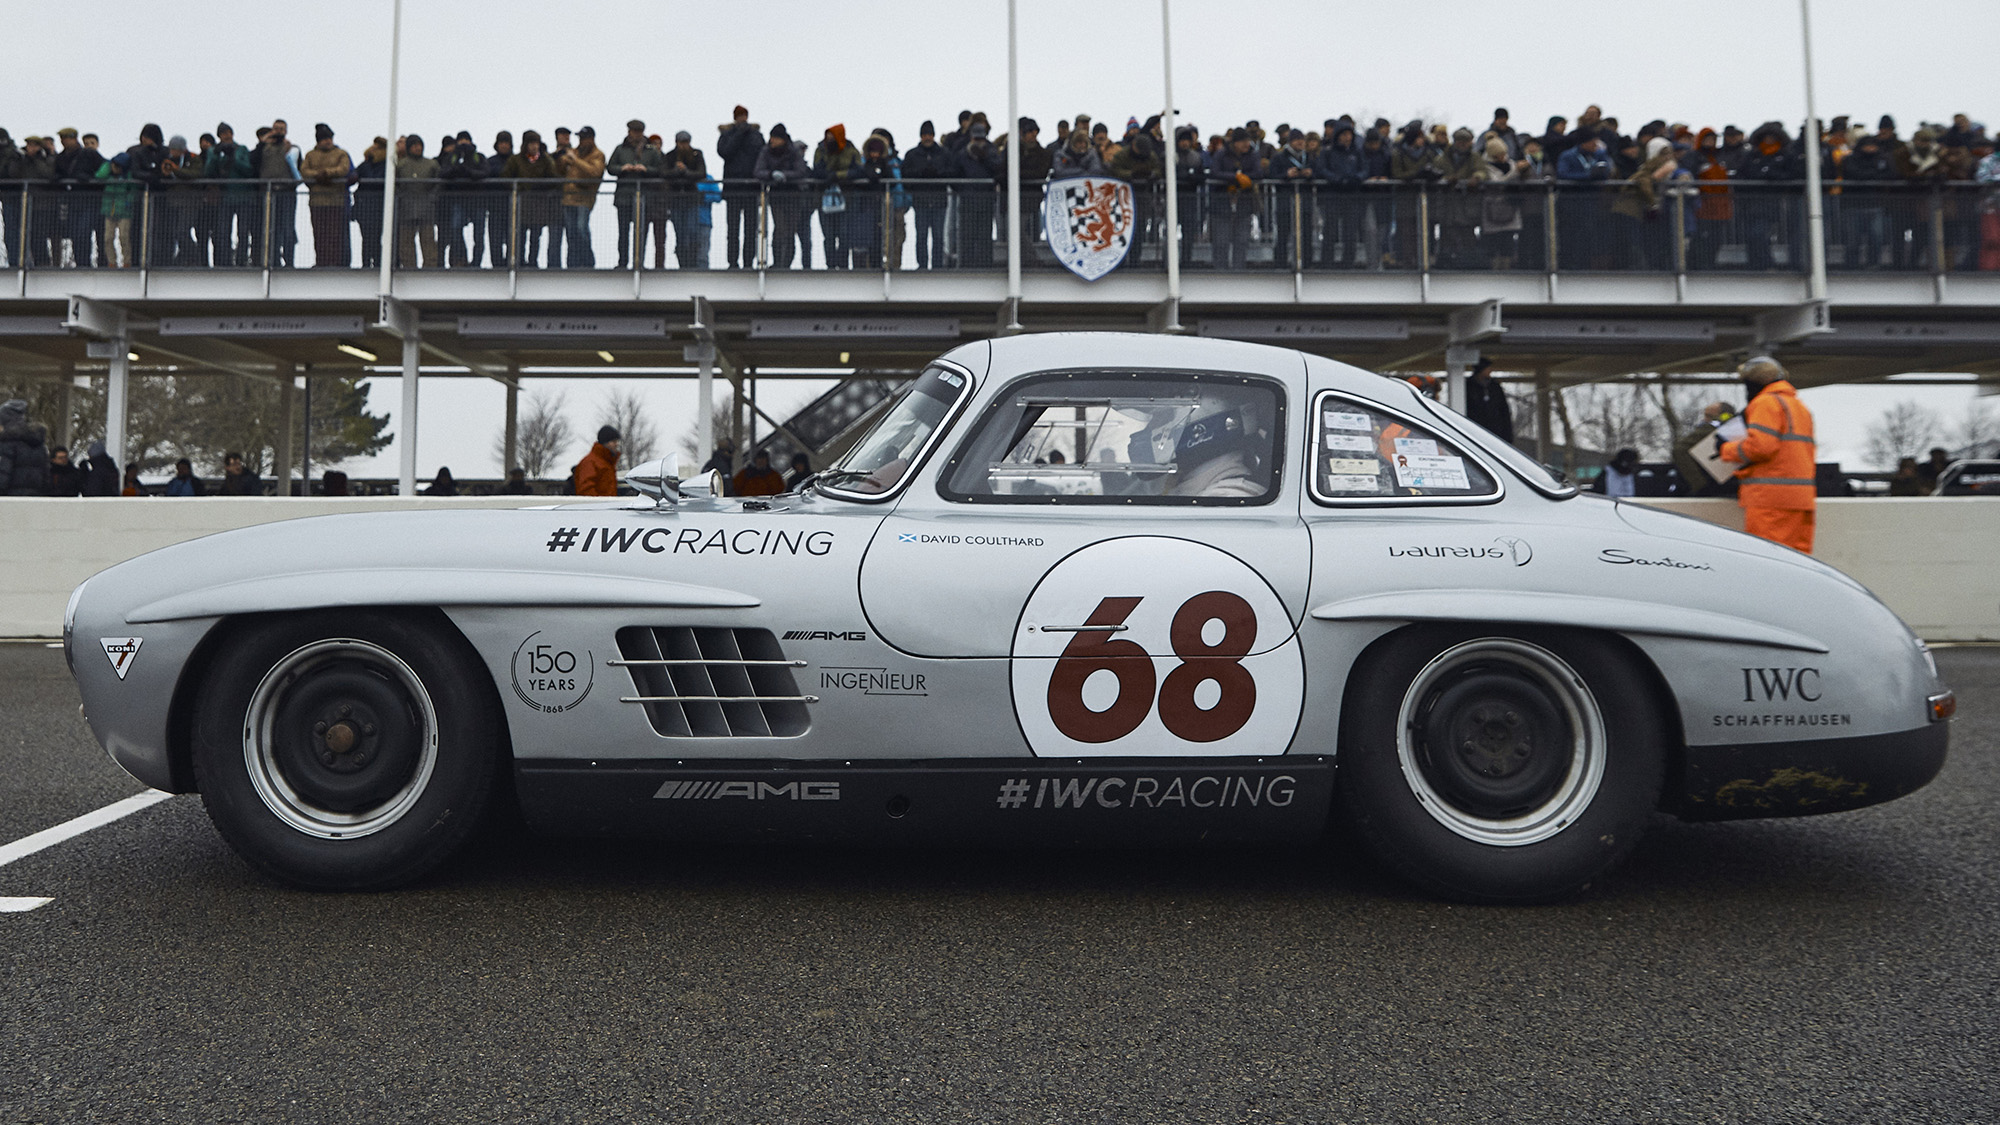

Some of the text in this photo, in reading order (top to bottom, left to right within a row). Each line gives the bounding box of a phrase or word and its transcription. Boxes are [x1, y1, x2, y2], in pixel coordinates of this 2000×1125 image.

[921, 535, 1044, 547] DAVID COULTHARD
[528, 645, 577, 674] 150
[1047, 590, 1258, 744] 68
[528, 679, 576, 690] YEARS
[820, 673, 927, 690] INGENIEUR
[1741, 668, 1823, 702] IWC
[543, 705, 564, 713] 1868
[1713, 714, 1852, 727] SCHAFFHAUSEN
